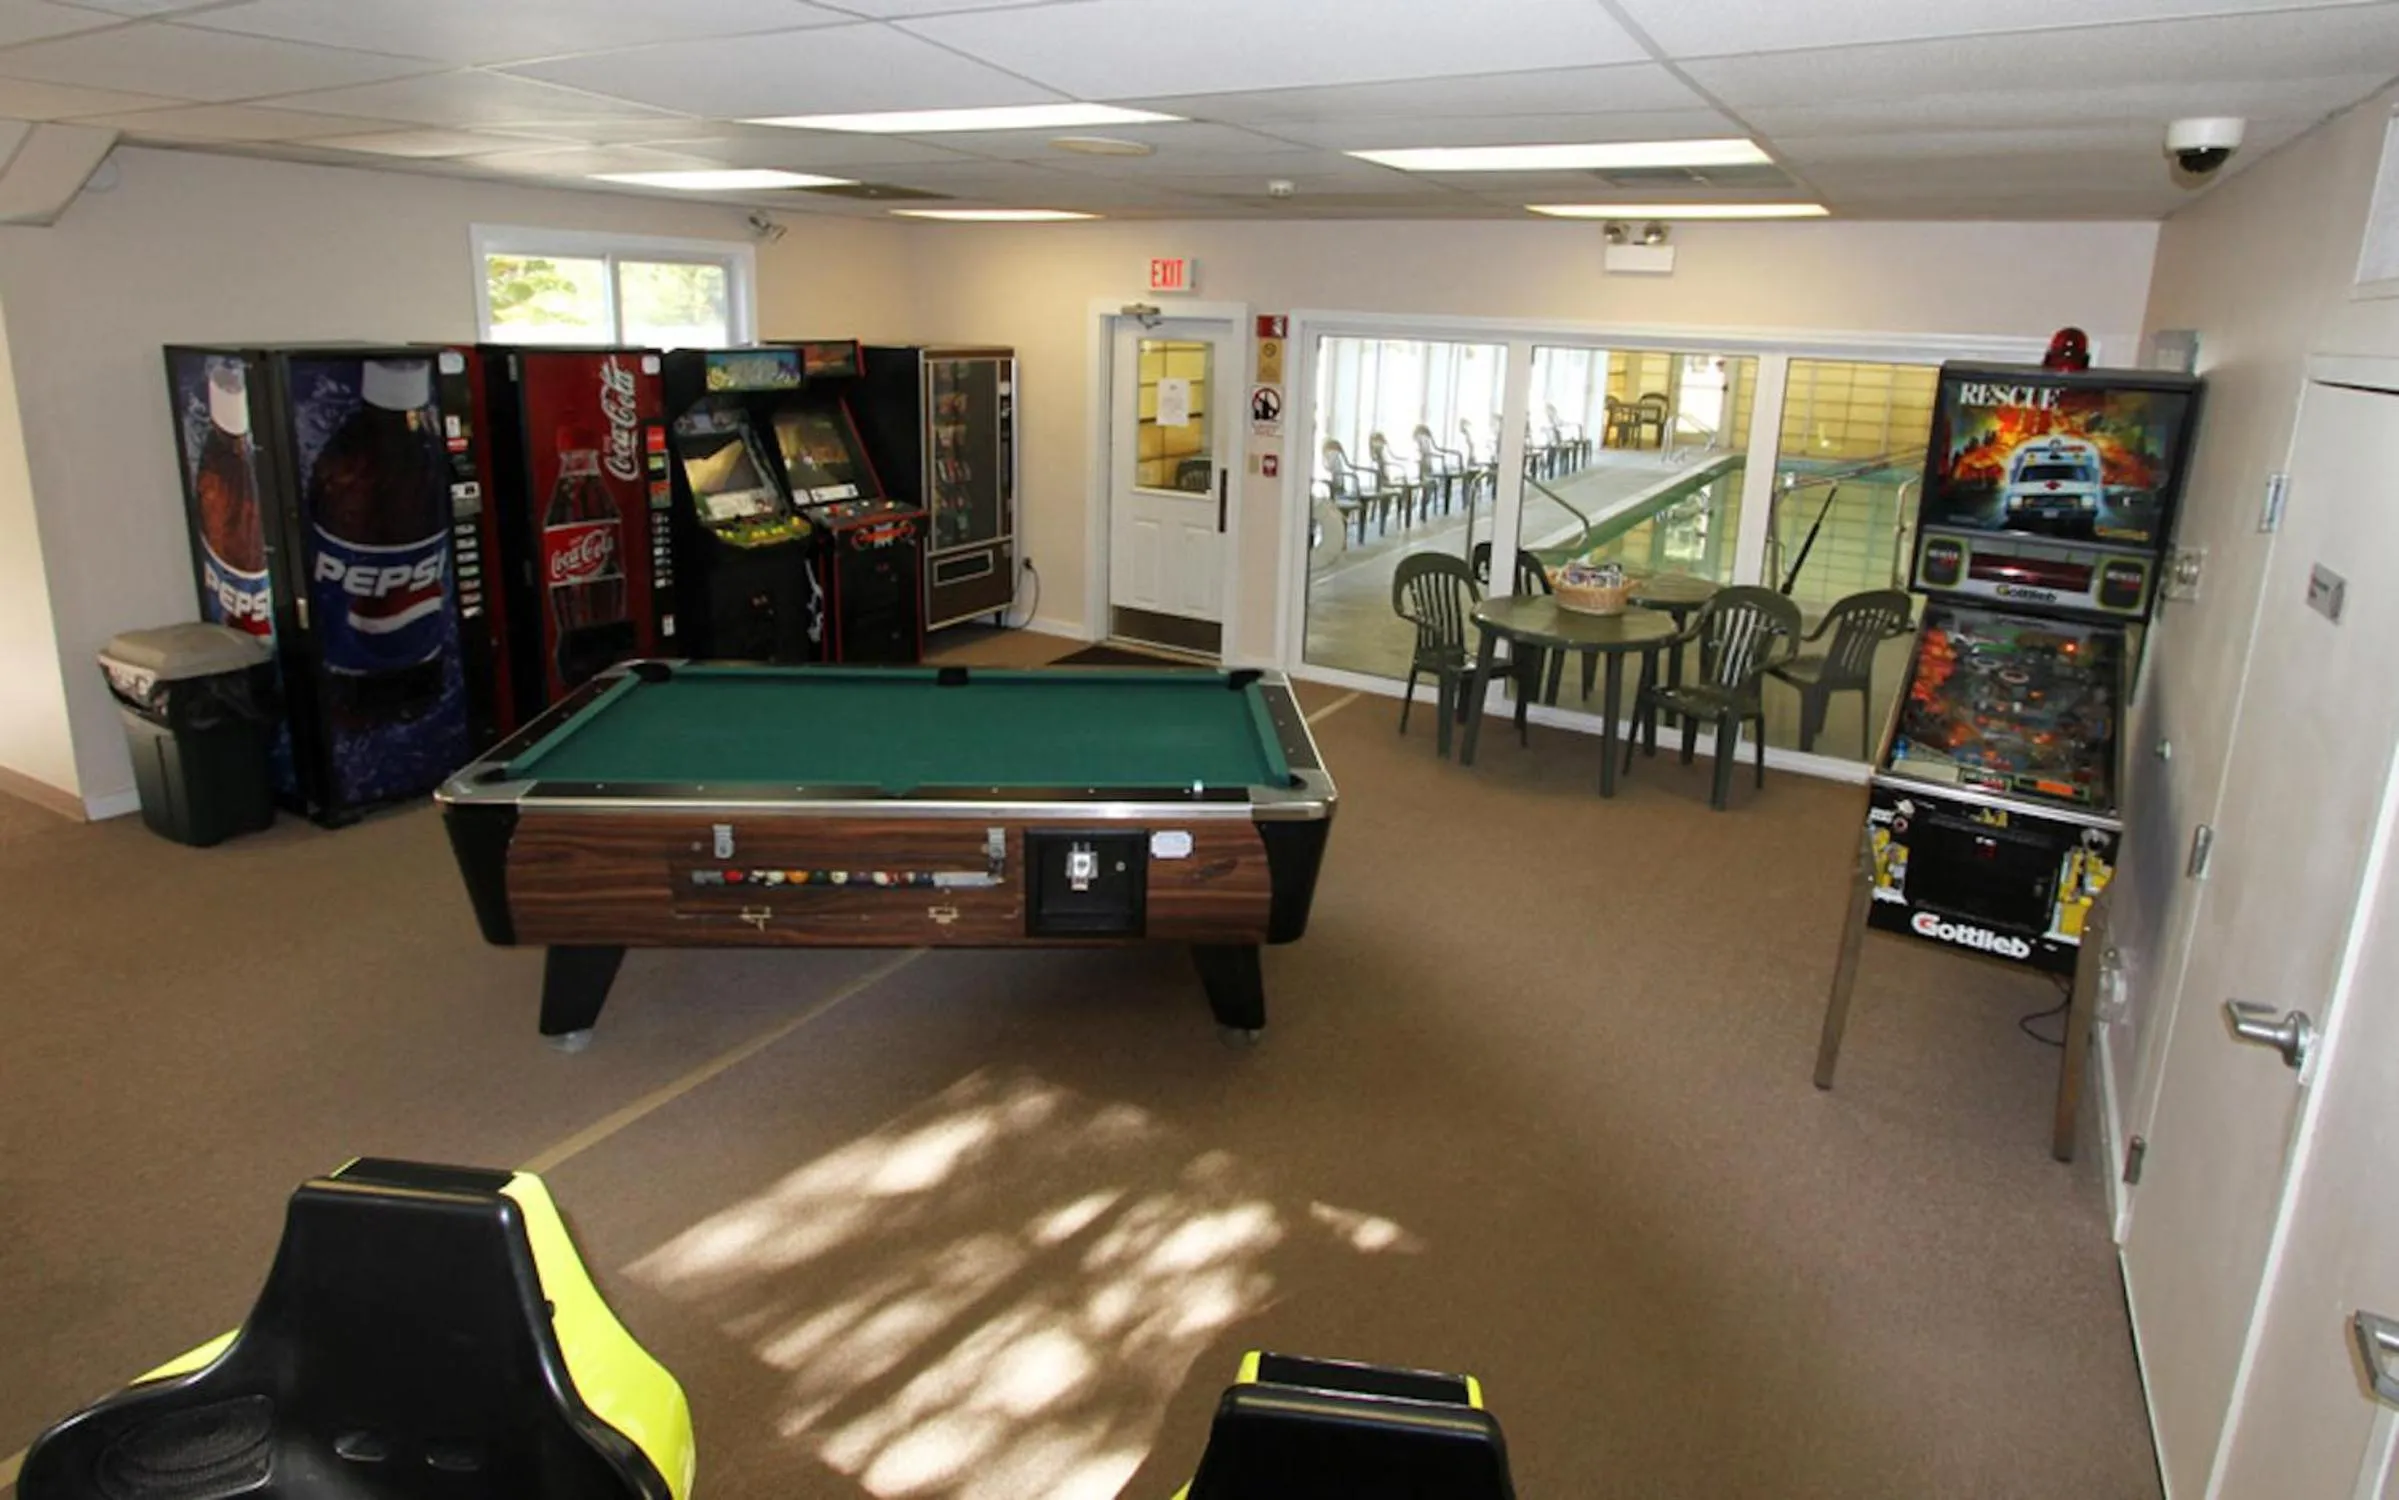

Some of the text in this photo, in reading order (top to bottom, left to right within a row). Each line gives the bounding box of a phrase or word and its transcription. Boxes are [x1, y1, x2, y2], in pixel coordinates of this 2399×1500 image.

[1152, 258, 1184, 289] EXIT
[314, 547, 447, 598] PEPSI
[1911, 911, 2031, 959] Gottlieb
